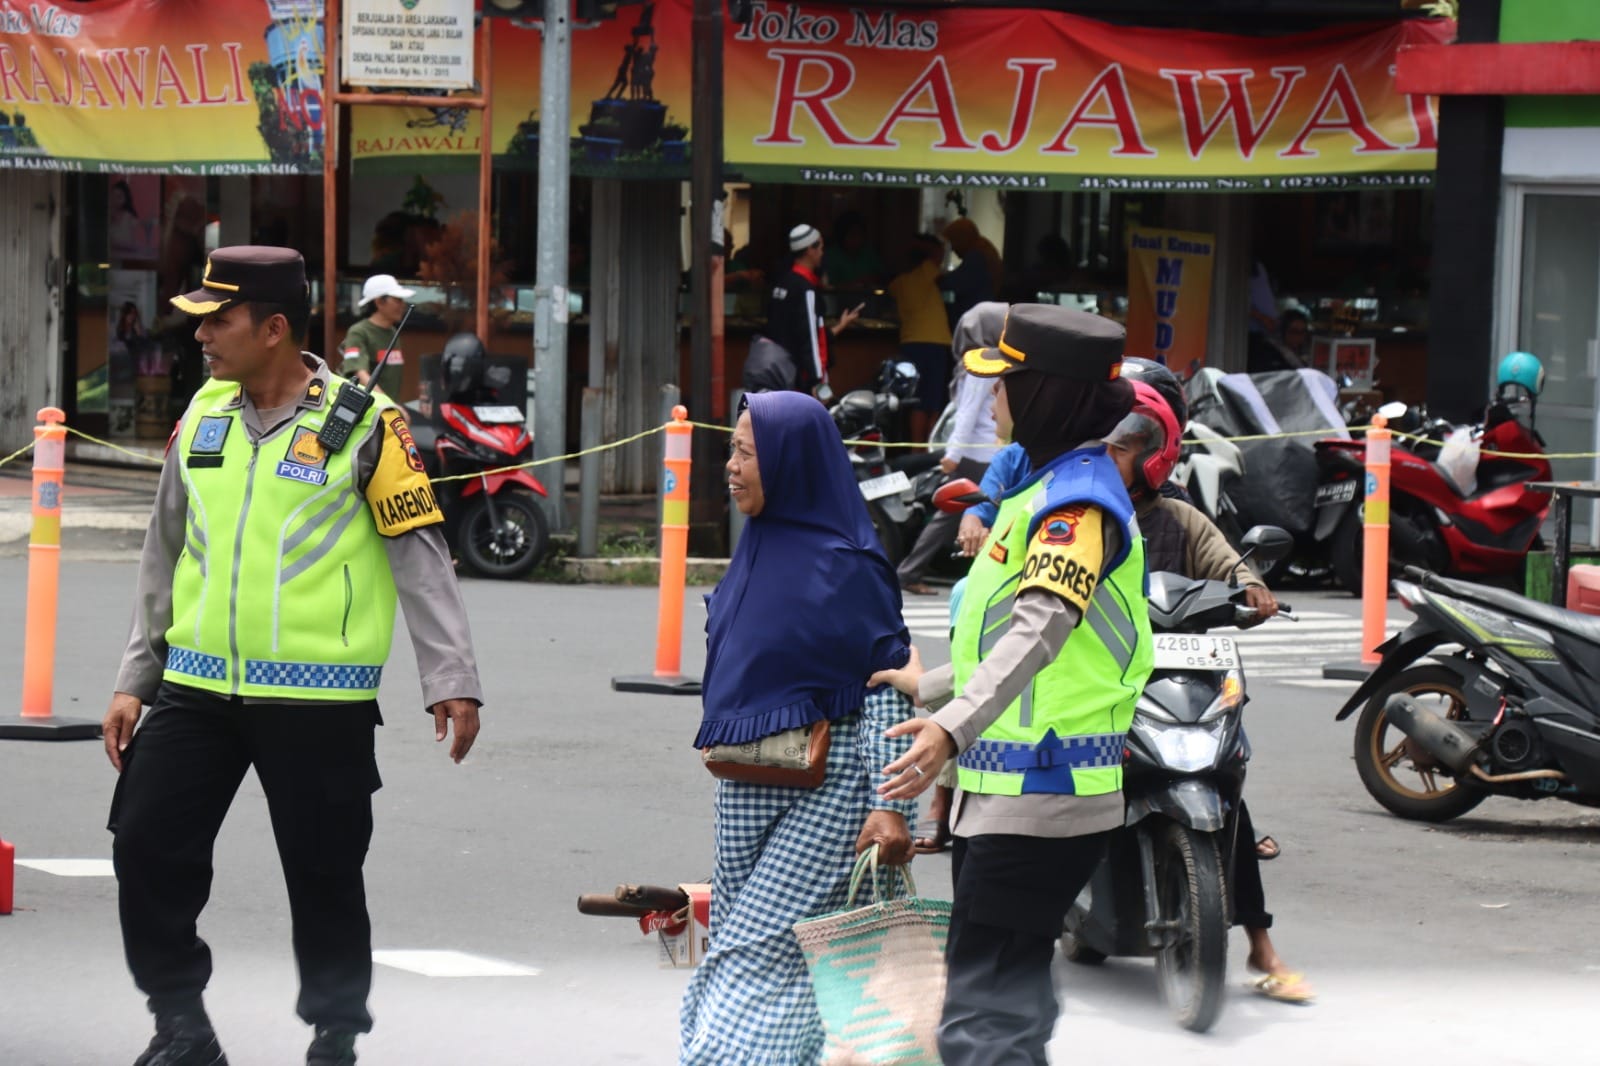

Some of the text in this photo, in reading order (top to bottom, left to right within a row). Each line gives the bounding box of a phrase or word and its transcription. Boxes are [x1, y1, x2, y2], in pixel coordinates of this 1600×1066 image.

[735, 0, 938, 49] Toko Mas
[0, 43, 249, 110] RAJAWALI
[355, 136, 481, 154] RAJAWALI
[800, 168, 855, 182] Toko
[862, 171, 908, 184] Mas
[915, 173, 1046, 188] RAJAWALI
[280, 464, 322, 482] POLRI
[1023, 552, 1095, 601] OPSRES
[1157, 636, 1201, 651] 4280
